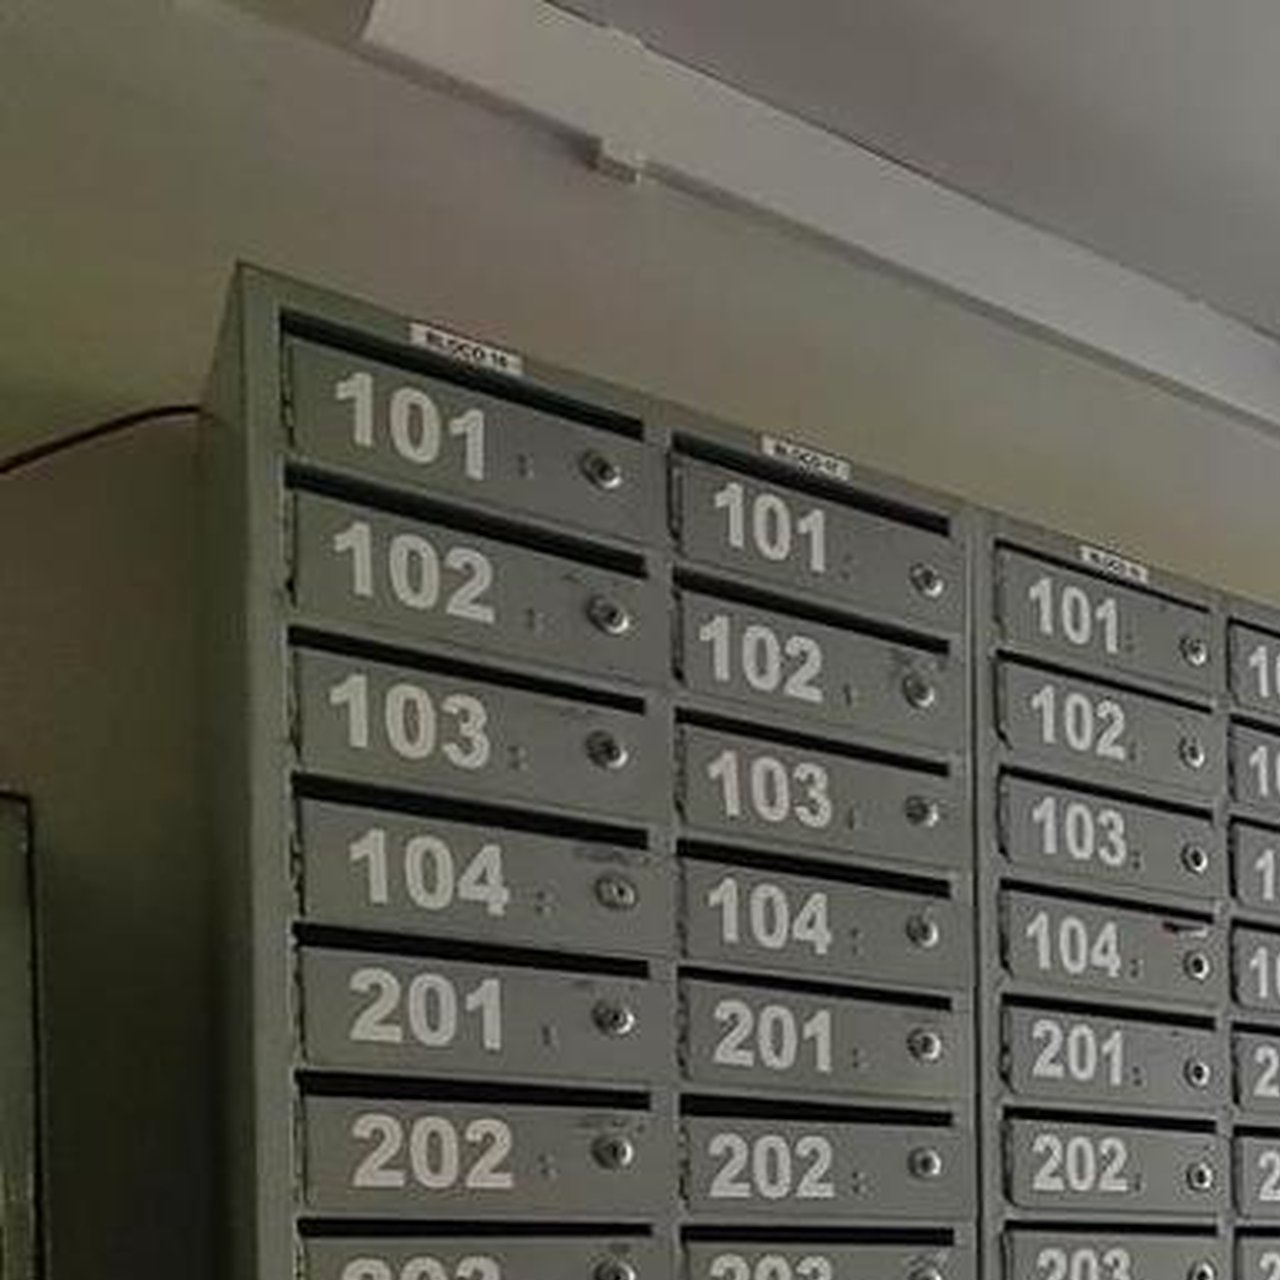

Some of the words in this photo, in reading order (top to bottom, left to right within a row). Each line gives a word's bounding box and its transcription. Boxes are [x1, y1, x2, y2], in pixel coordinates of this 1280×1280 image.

[336, 373, 484, 479] 101
[715, 483, 825, 572] 101
[335, 522, 494, 623] 102
[1030, 578, 1118, 653] 101
[700, 615, 823, 703] 102
[330, 675, 490, 768] 103
[1032, 685, 1125, 760] 102
[708, 751, 832, 827] 103
[1033, 797, 1126, 866] 103
[350, 829, 509, 915] 104
[709, 878, 832, 954] 104
[1027, 912, 1121, 977] 104
[351, 968, 500, 1049] 201
[714, 1000, 831, 1072] 201
[1033, 1020, 1122, 1085] 201
[353, 1114, 513, 1188] 202
[709, 1134, 835, 1199] 202
[1033, 1135, 1128, 1191] 202
